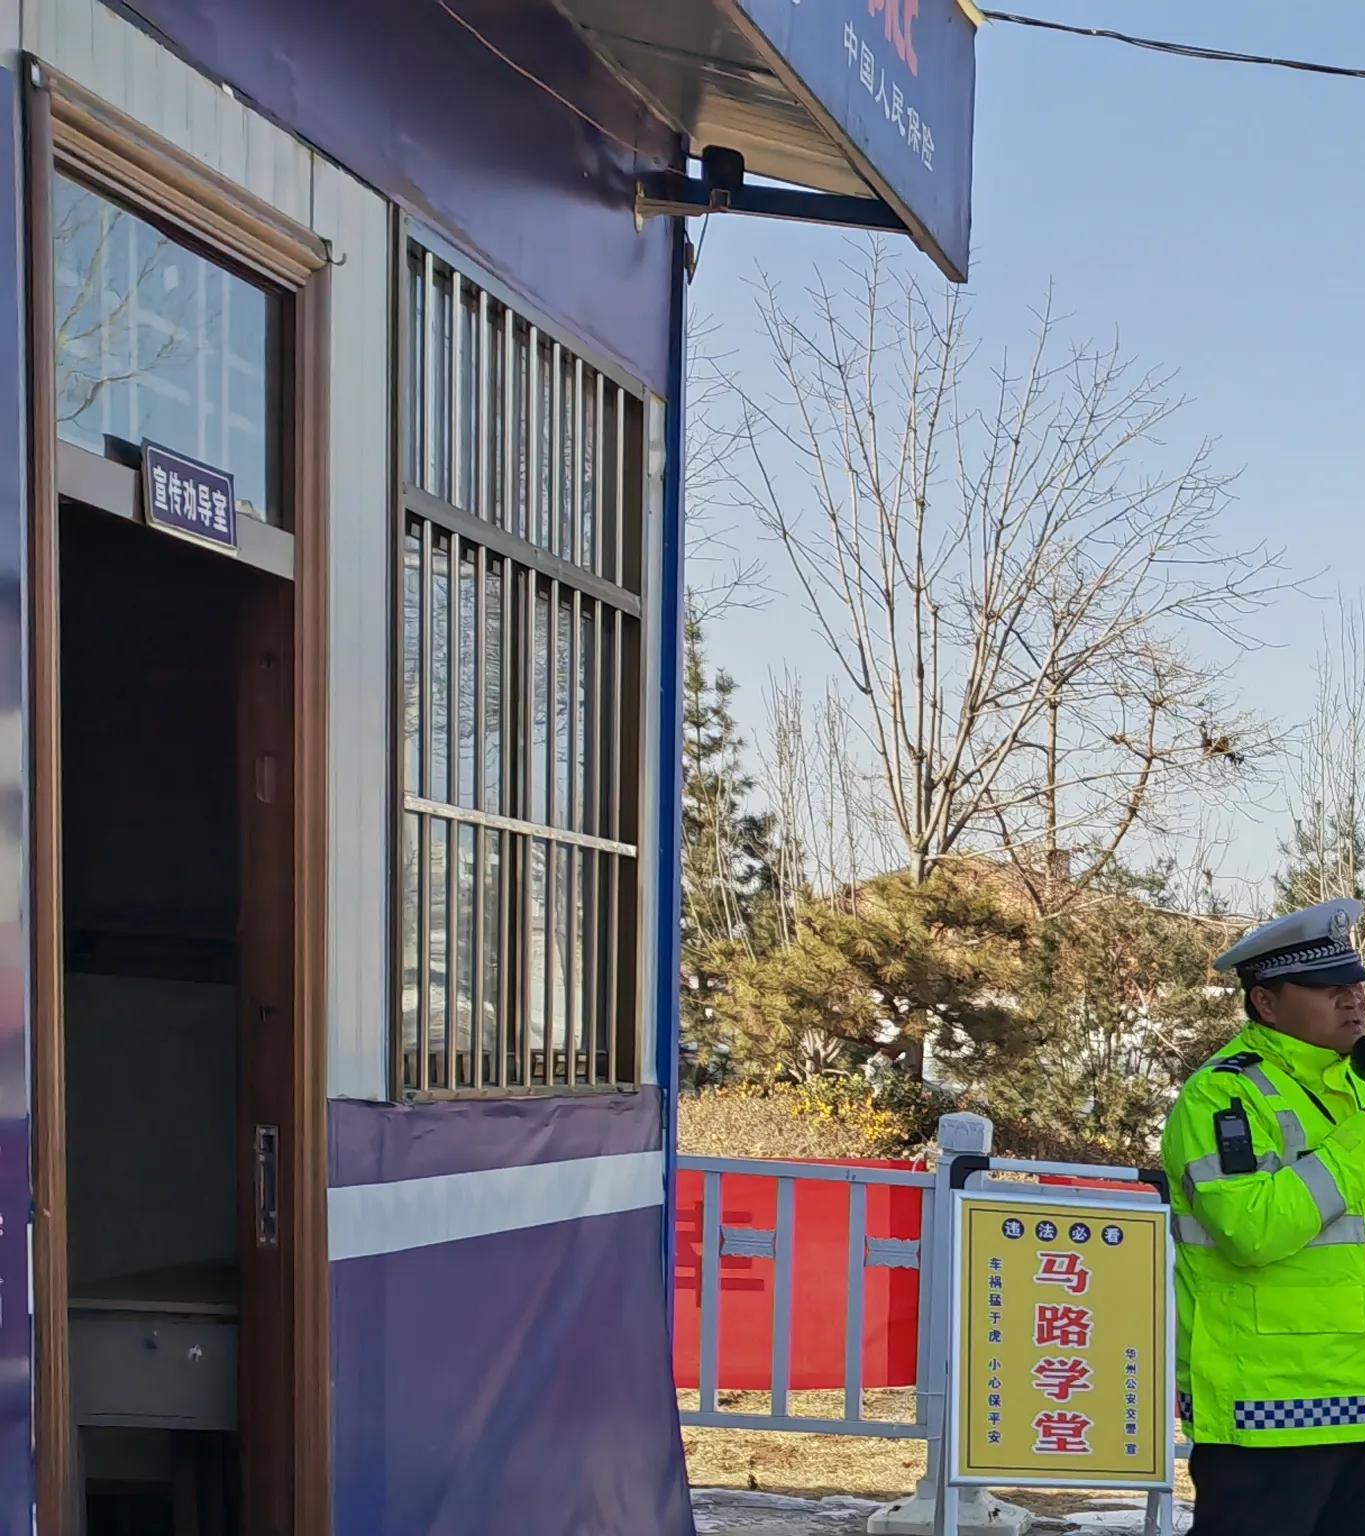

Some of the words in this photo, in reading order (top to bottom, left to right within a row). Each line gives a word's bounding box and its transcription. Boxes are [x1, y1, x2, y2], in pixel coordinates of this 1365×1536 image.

[842, 20, 936, 172] 中国人民保险
[152, 464, 229, 534] 宣传劝导室
[1002, 1218, 1124, 1246] 违法必看
[987, 1256, 1004, 1345] 车祸猛于虎
[1031, 1249, 1095, 1457] 马路学堂
[1124, 1347, 1139, 1436] 华州公安交警
[986, 1358, 1003, 1446] 小心保平安
